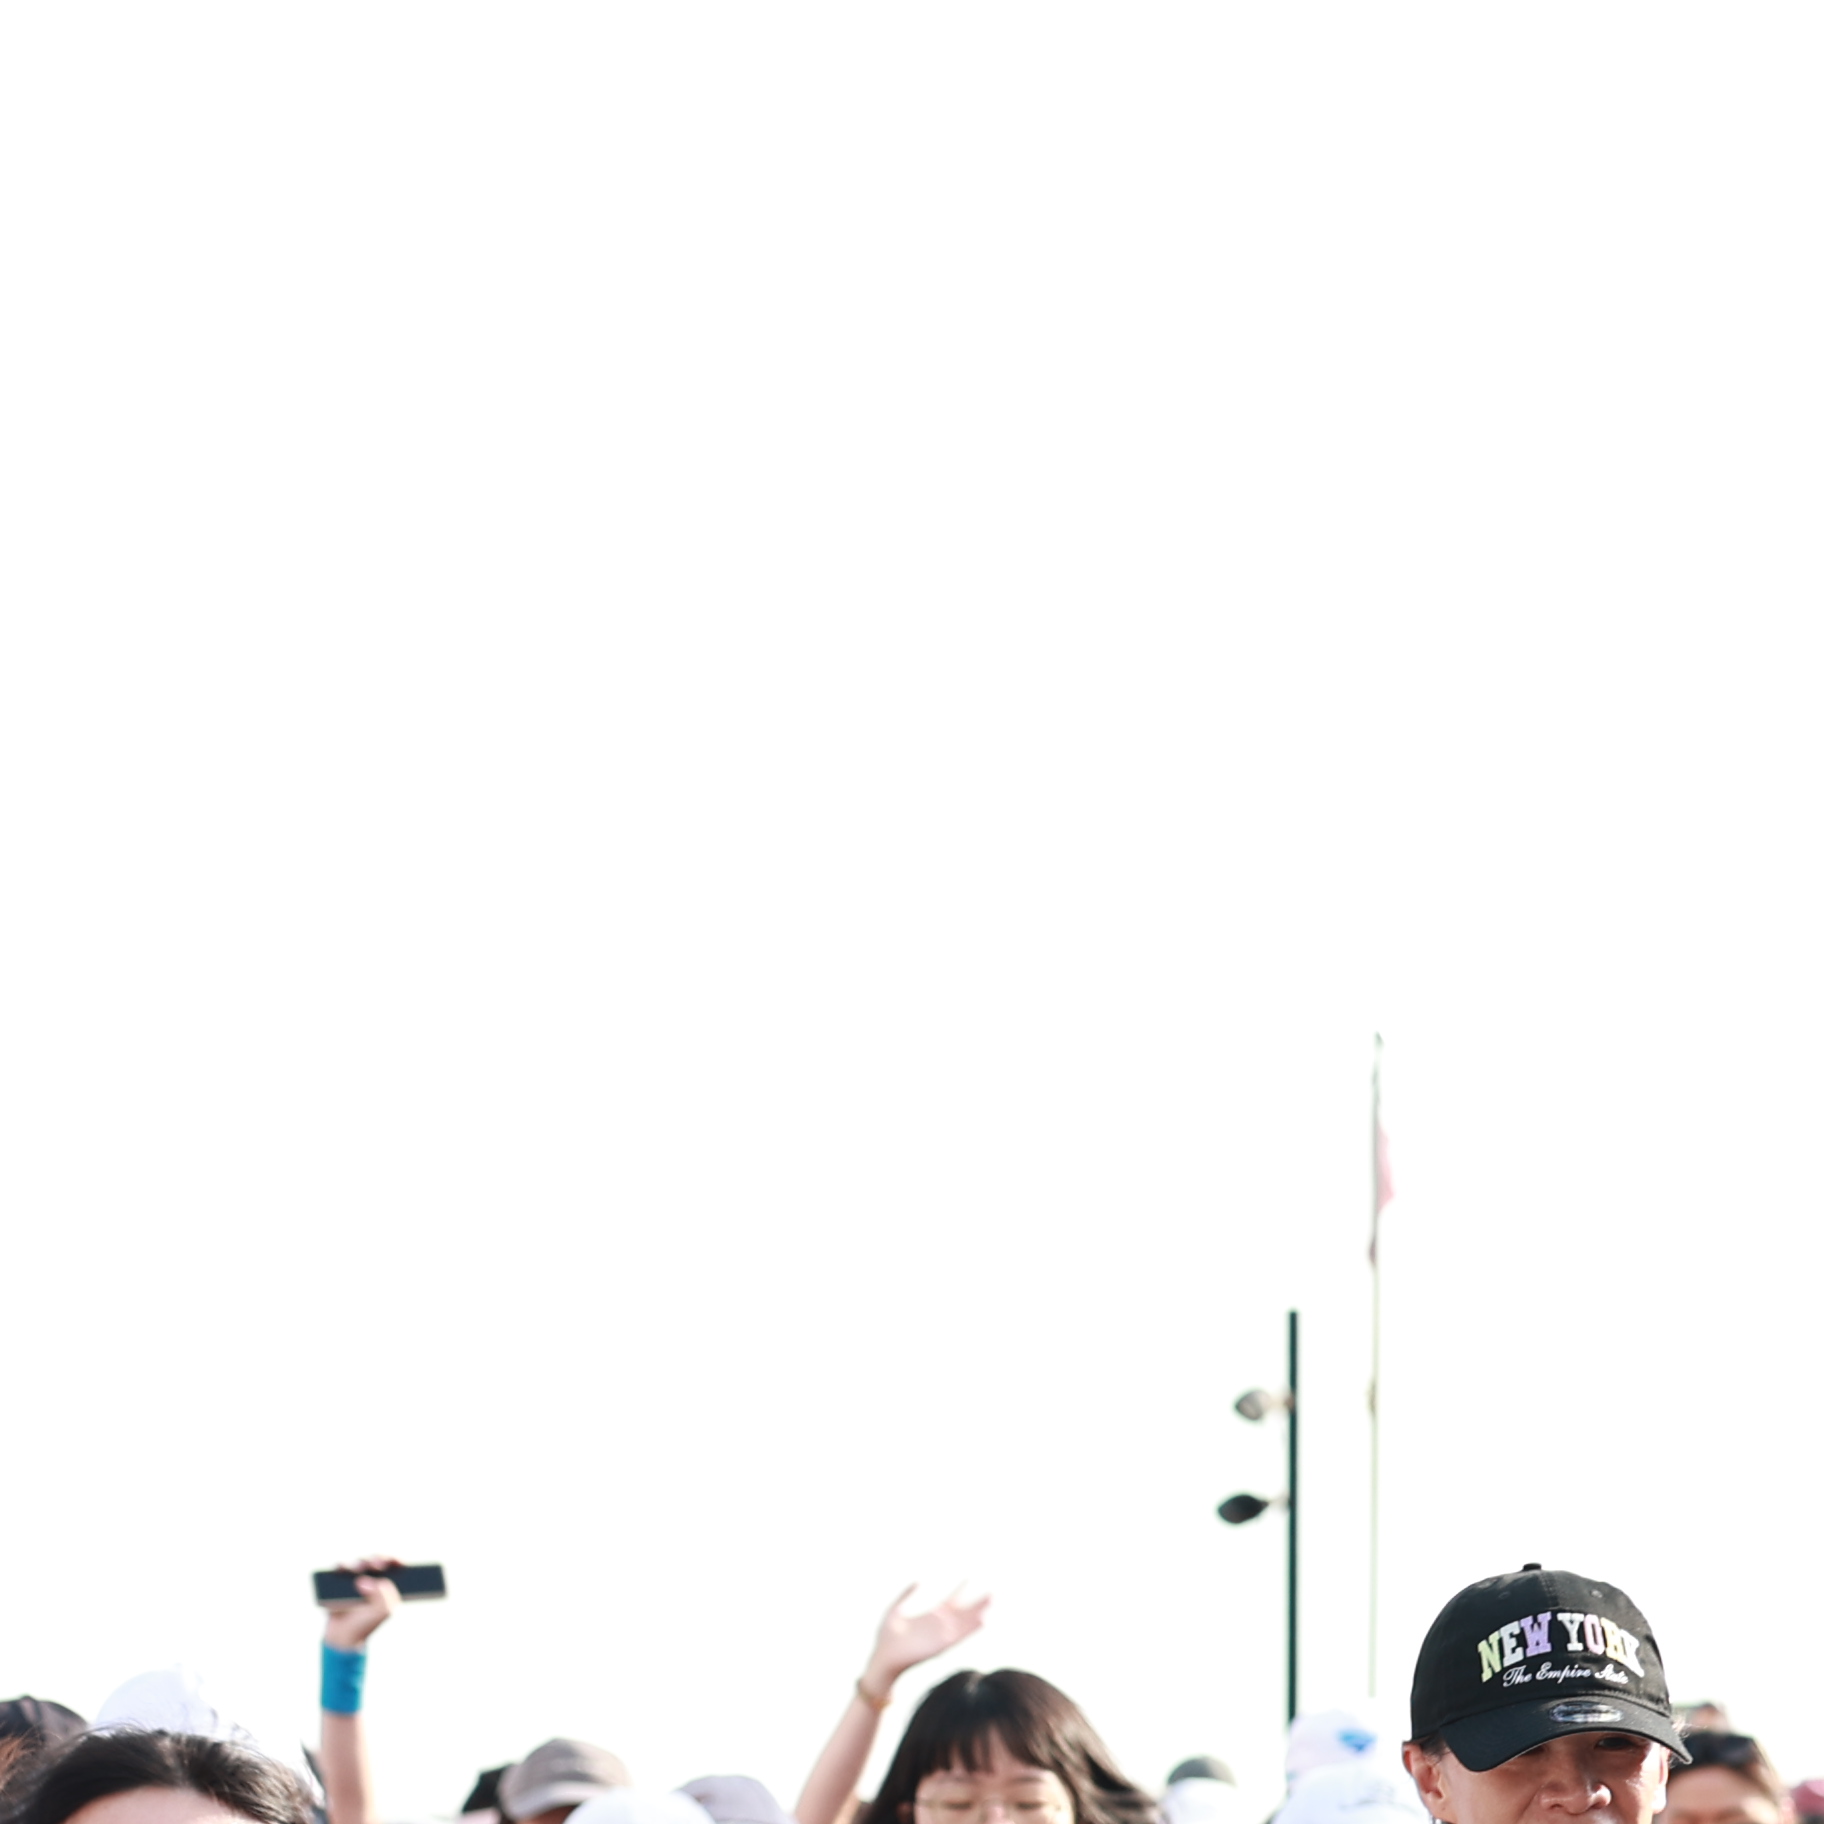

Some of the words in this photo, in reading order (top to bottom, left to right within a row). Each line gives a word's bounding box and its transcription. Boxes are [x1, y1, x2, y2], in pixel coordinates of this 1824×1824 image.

[1477, 1611, 1552, 1683] NEW
[1556, 1612, 1645, 1678] YORK
[1502, 1664, 1533, 1688] The
[1535, 1661, 1592, 1684] Empire
